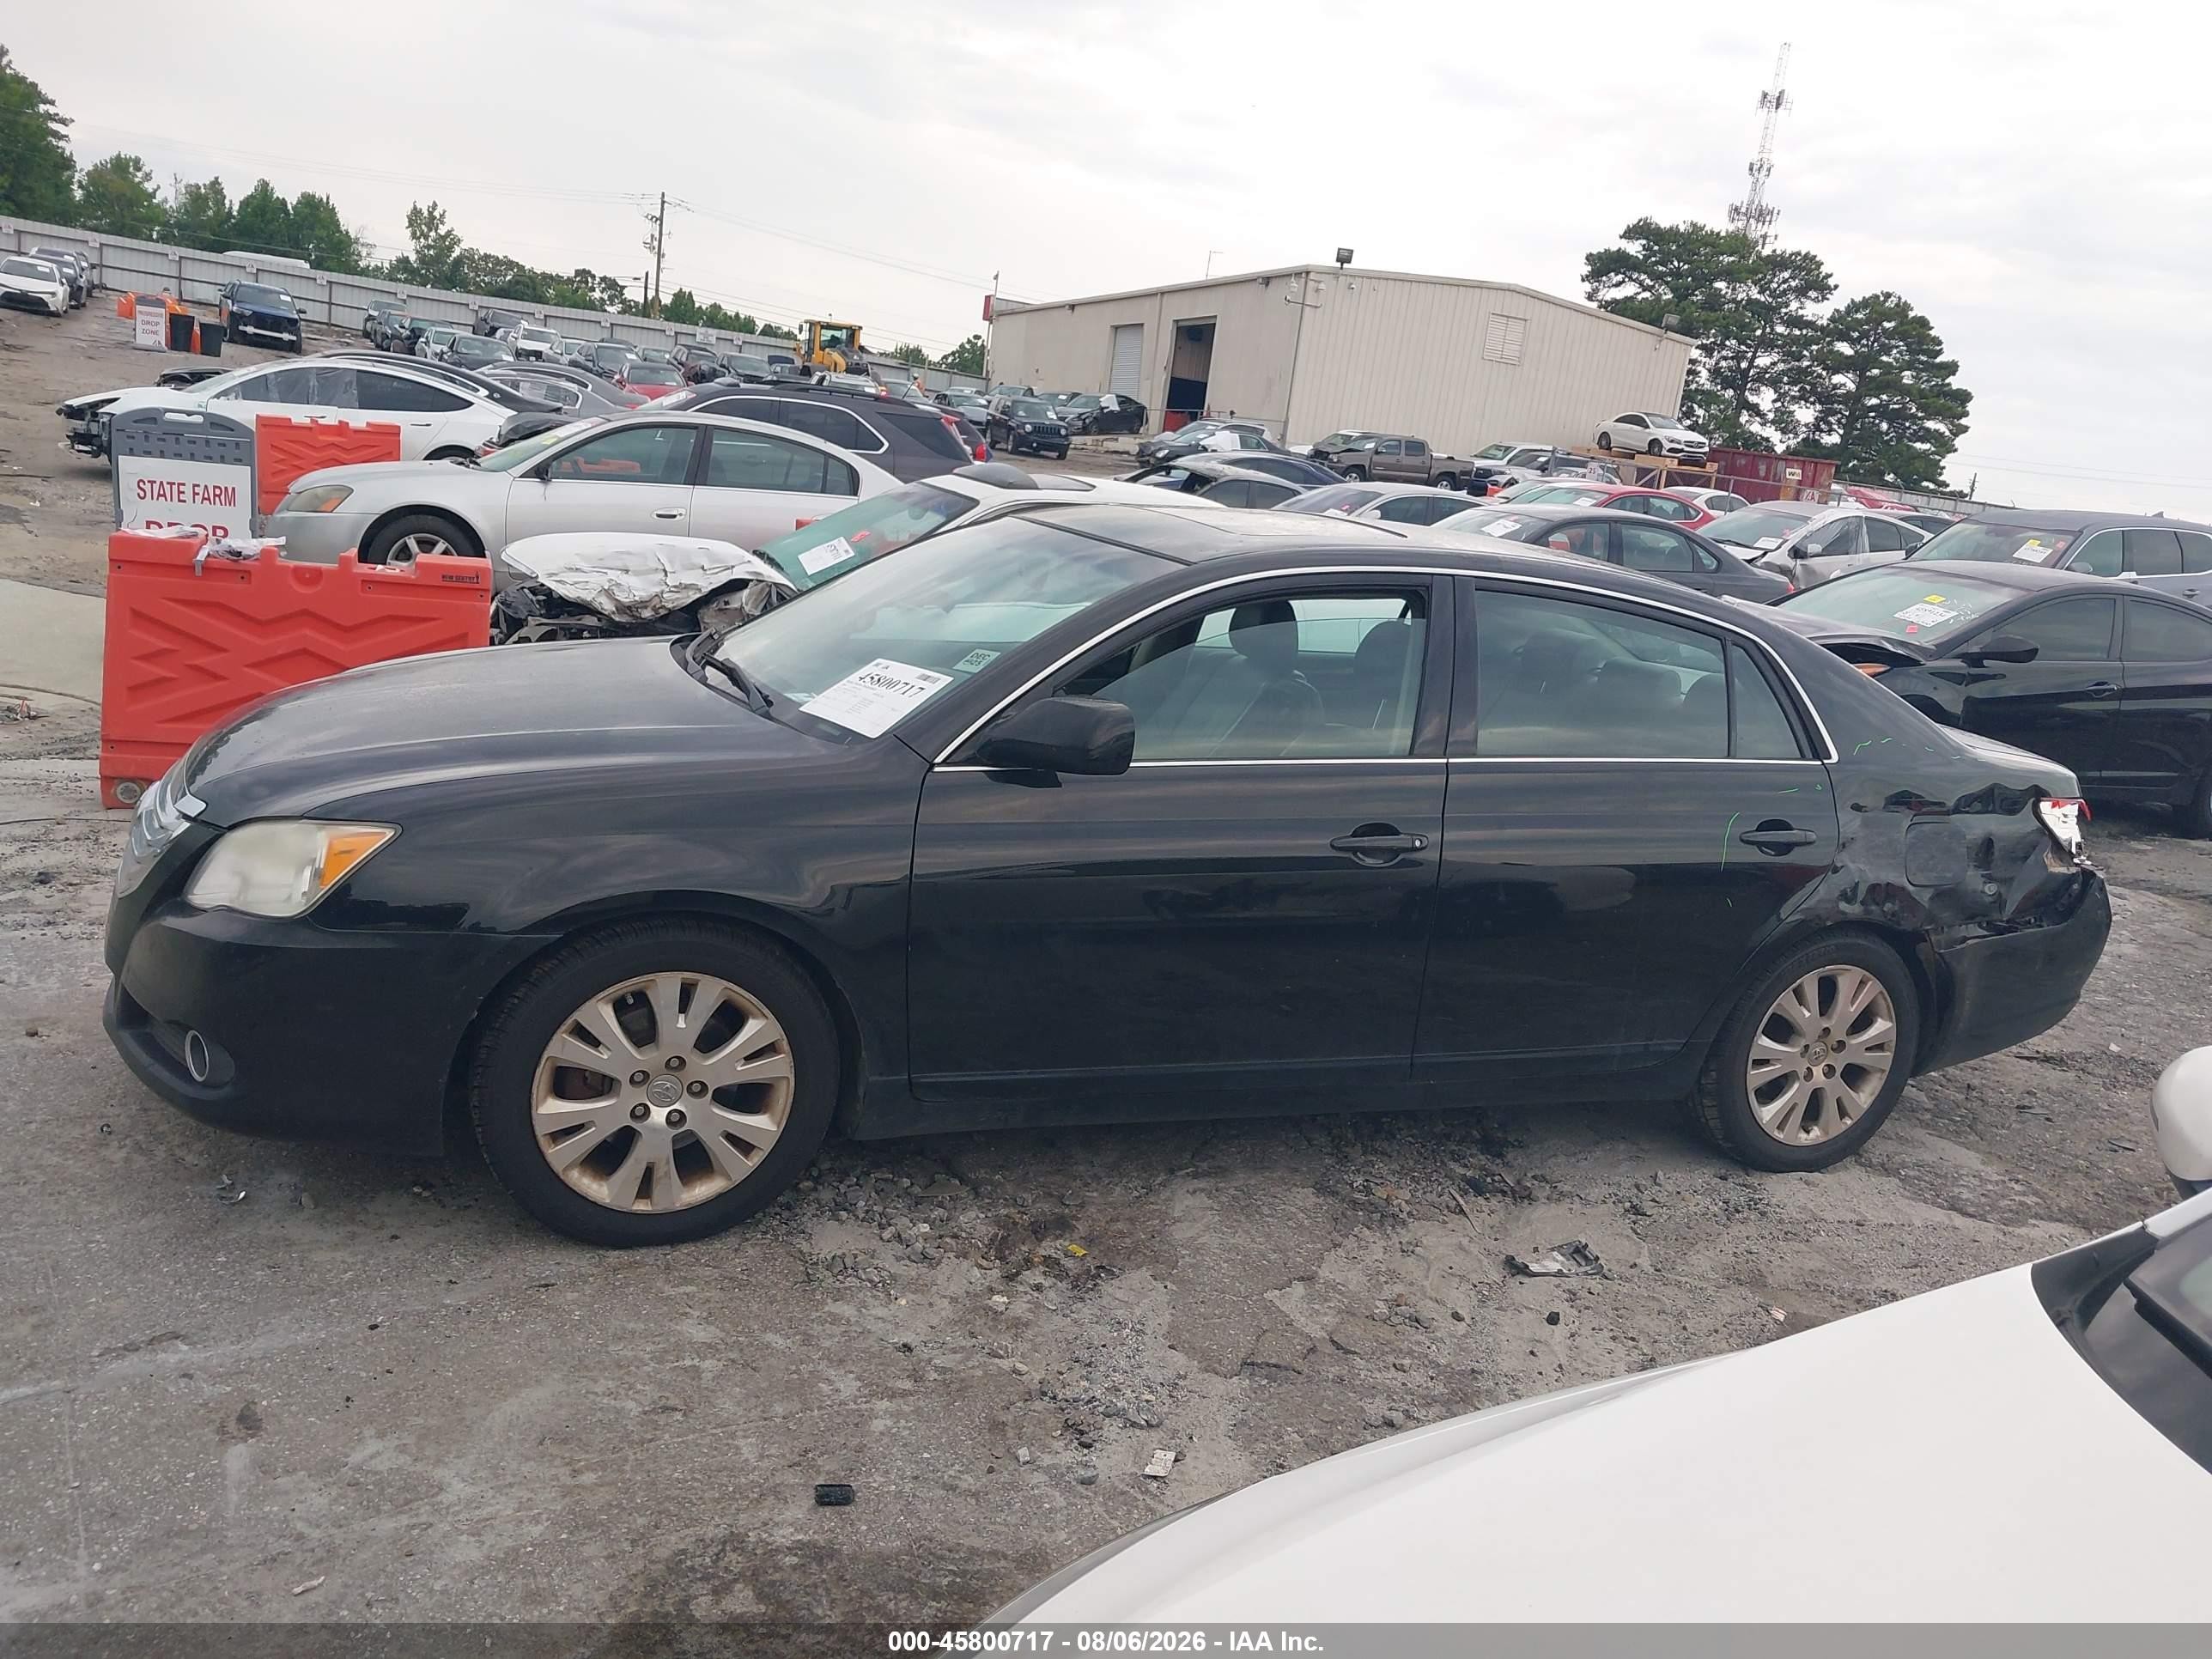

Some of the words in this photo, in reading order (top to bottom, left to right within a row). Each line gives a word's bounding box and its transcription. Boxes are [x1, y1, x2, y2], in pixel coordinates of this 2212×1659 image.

[141, 319, 161, 327] DROP
[136, 477, 187, 504] STATE
[191, 483, 237, 507] FARM
[969, 652, 991, 660] DEC
[858, 672, 926, 698] 45800717
